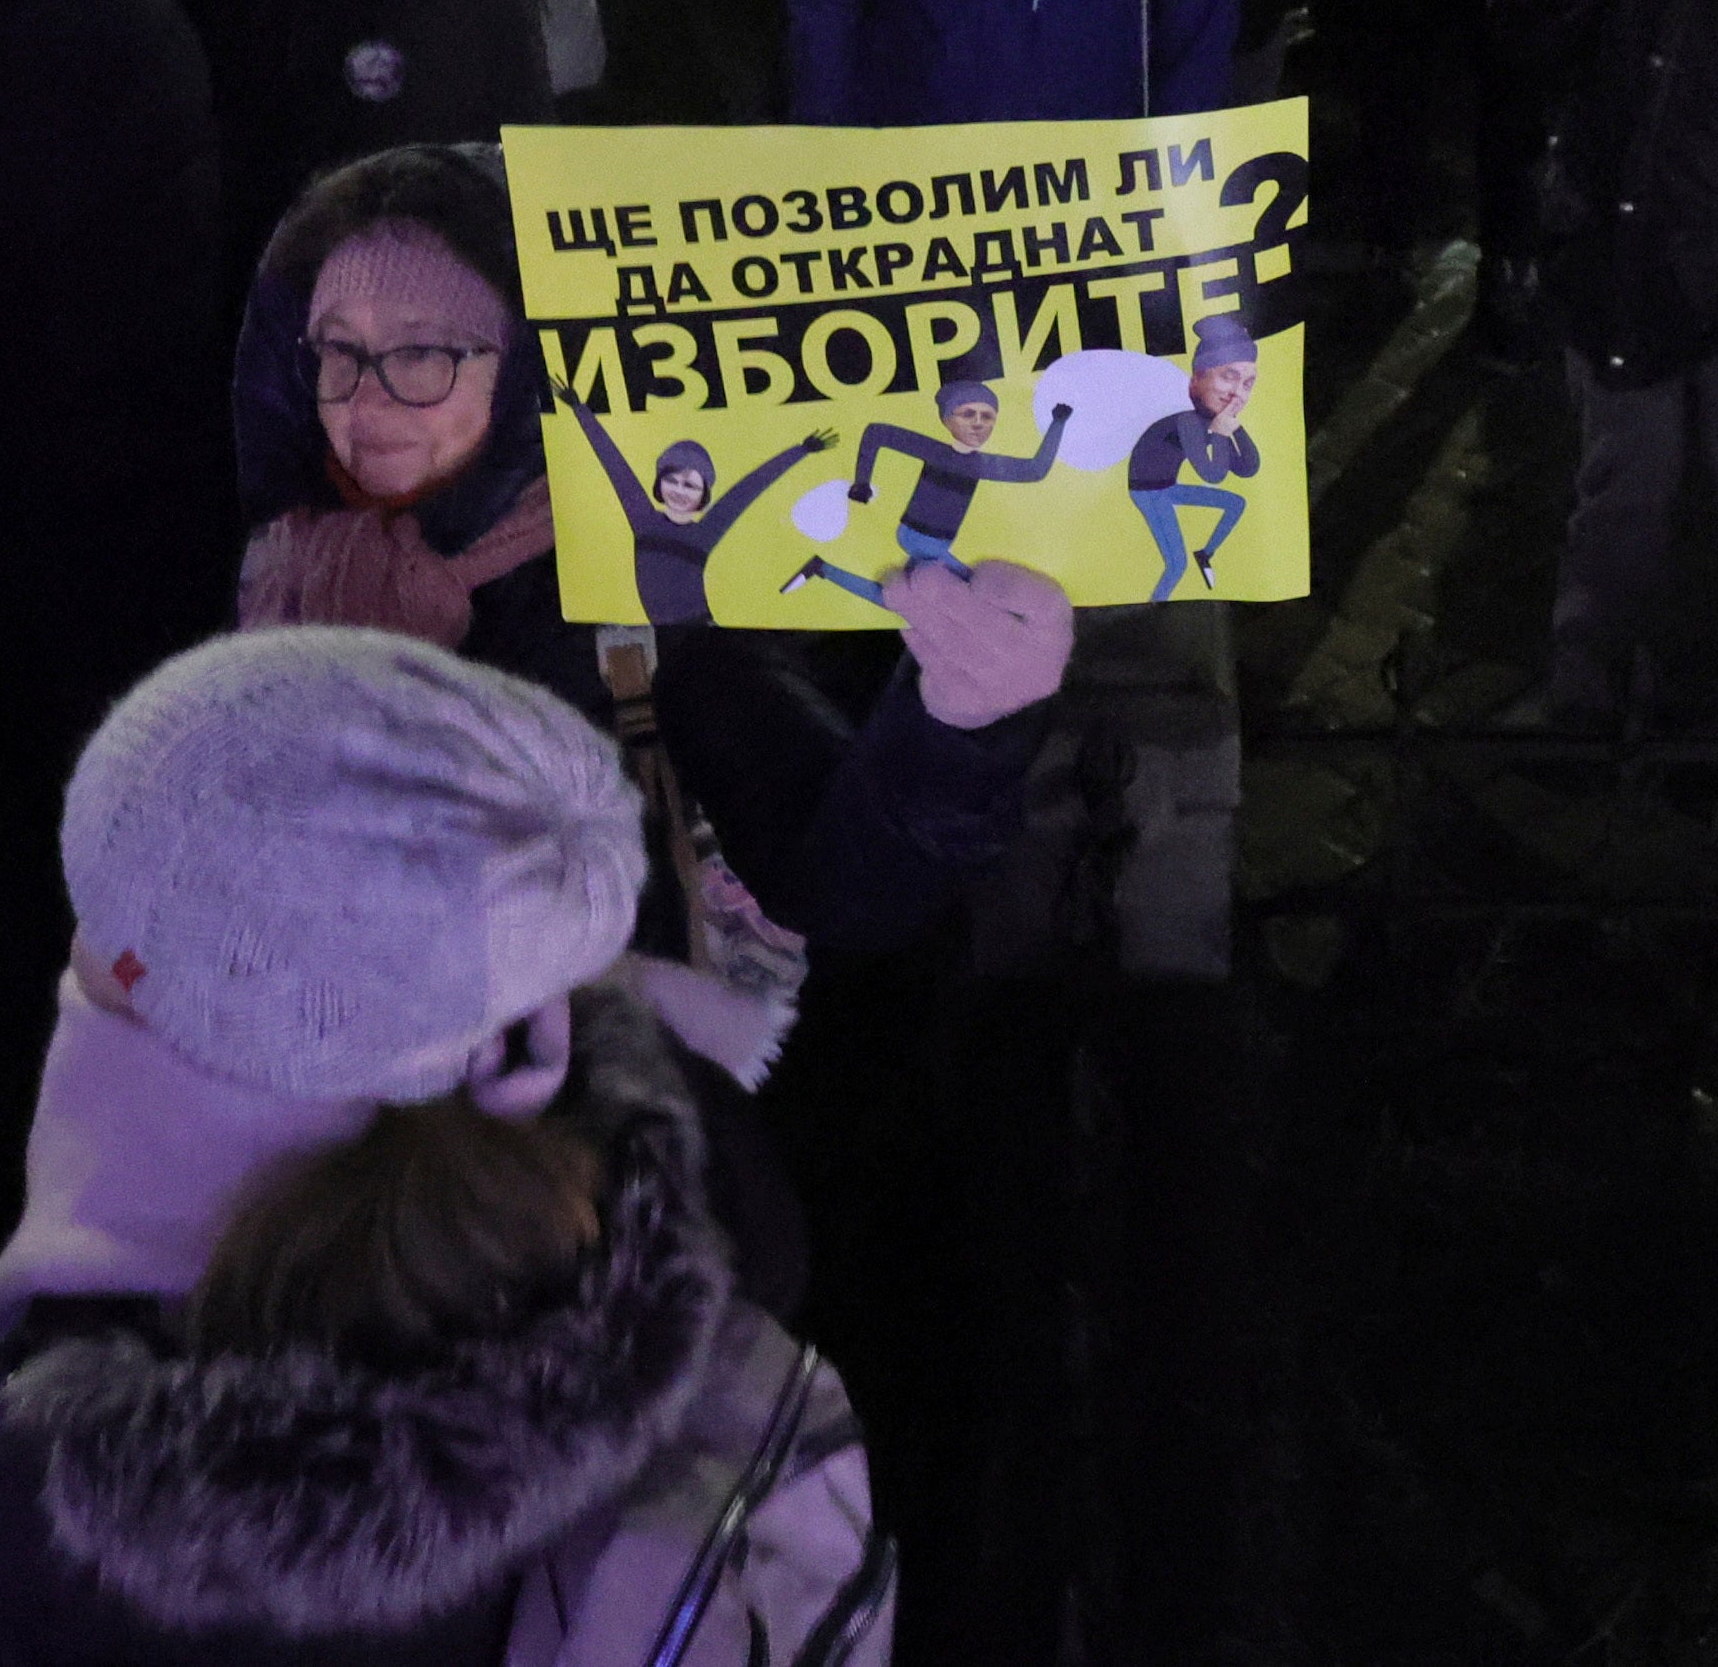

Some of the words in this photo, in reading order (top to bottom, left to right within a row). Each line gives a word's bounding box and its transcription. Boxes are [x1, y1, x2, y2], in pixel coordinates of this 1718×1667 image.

[545, 204, 658, 258] ЩЕ
[678, 158, 1090, 243] ПОЗВОЛИМ
[1115, 137, 1215, 196] ЛИ
[615, 262, 713, 317] ДА
[731, 207, 1165, 298] ОТКРАДНАТ
